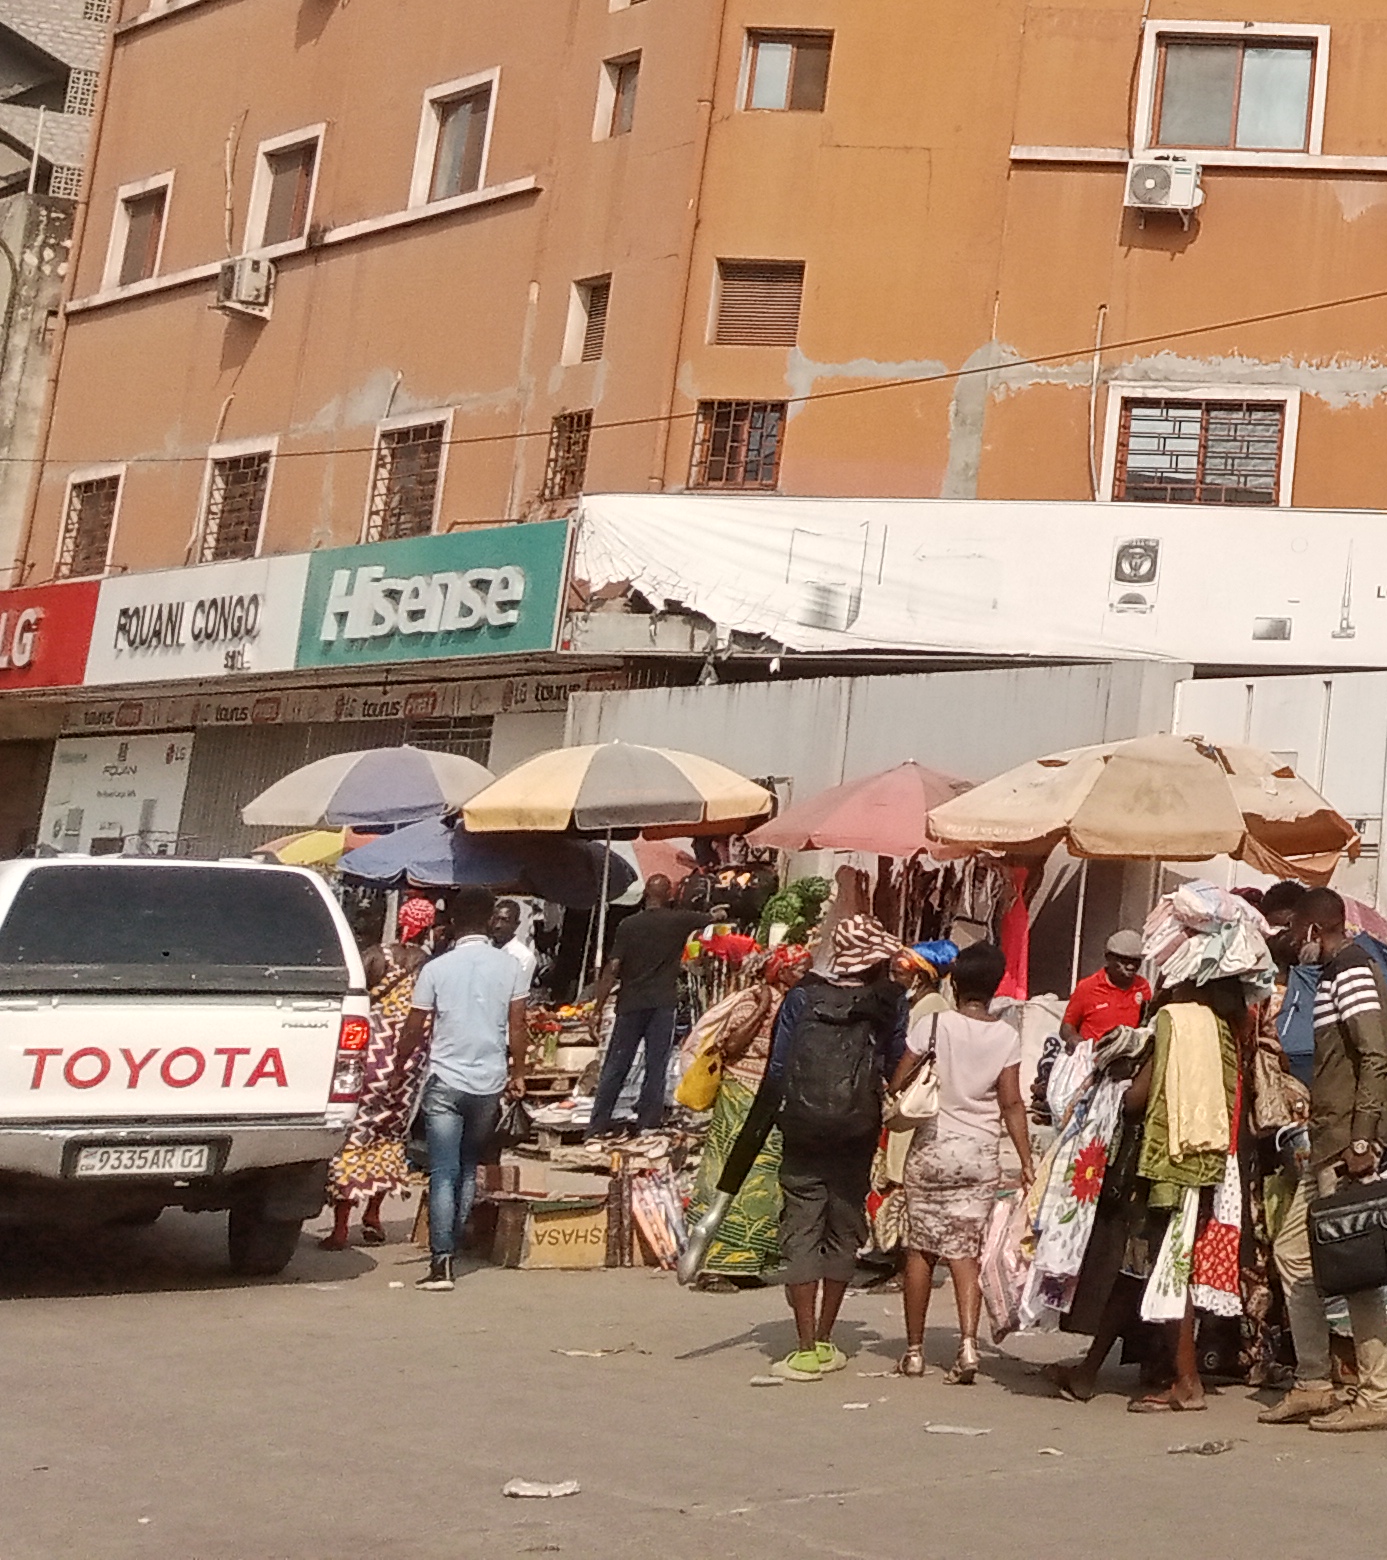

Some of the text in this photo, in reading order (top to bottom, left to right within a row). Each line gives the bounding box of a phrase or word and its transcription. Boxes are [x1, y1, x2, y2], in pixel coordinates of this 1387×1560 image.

[115, 593, 261, 651] FOUANI CONGO
[320, 564, 525, 641] Hisense
[0, 607, 37, 669] LG
[23, 1046, 289, 1090] TOYOTA
